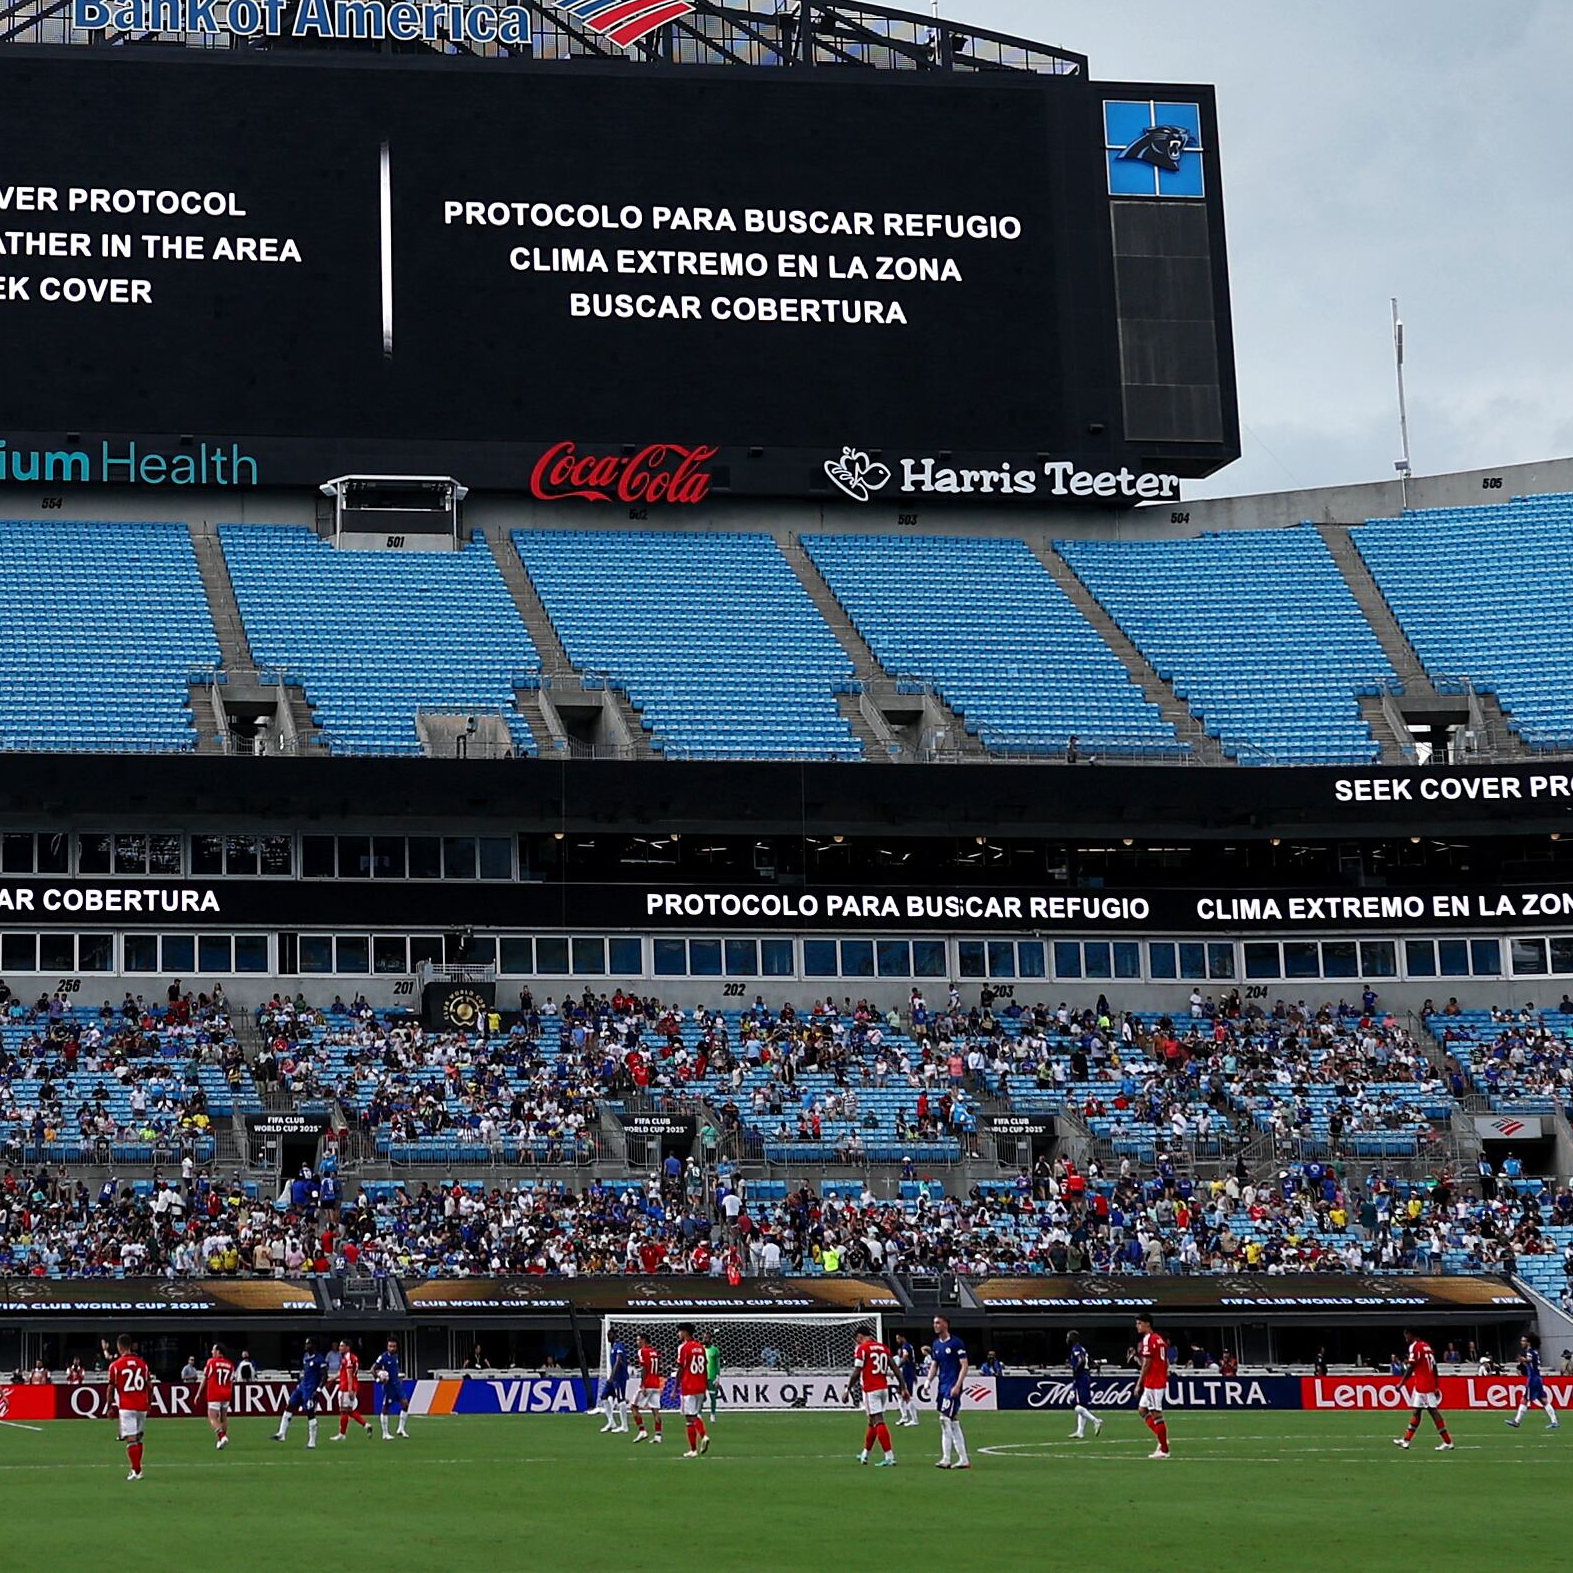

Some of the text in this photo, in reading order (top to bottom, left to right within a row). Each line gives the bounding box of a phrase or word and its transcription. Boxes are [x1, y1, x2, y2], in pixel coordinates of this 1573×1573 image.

[68, 187, 247, 216] PROTOCOL
[444, 201, 1021, 240] PROTOCOLO PARA BUSCAR REFUGIO
[101, 233, 131, 258] IN
[141, 234, 205, 260] THE
[212, 236, 302, 263] AREA
[509, 246, 963, 282] CLIMA EXTREMO EN LA ZONA
[39, 277, 153, 304] COVER
[570, 293, 908, 325] BUSCAR COBERTURA
[102, 440, 258, 485] Health
[530, 440, 719, 504] Coca-Cola
[900, 458, 1179, 497] Harris Teeter
[1482, 477, 1503, 490] 505
[41, 497, 63, 510] 554
[897, 513, 918, 526] 503
[1170, 512, 1190, 524] 504
[386, 536, 405, 548] 501
[1335, 778, 1413, 802] SEEK
[1420, 777, 1522, 800] COVER
[42, 888, 221, 912] COBERTURA
[647, 893, 1150, 919] PROTOCOLO PARA BUSCAR REFUGIO
[1196, 898, 1283, 920] CLIMA
[1288, 896, 1425, 919] EXTREMO
[1432, 895, 1470, 917] EN
[1478, 894, 1517, 917] LA
[56, 978, 82, 993] 256
[393, 981, 414, 995] 201
[722, 983, 747, 997] 202
[991, 984, 1015, 999] 203
[1244, 985, 1268, 999] 204
[74, 1302, 132, 1310] WORLD
[650, 1357, 659, 1374] 11
[689, 1353, 705, 1375] 68
[869, 1351, 888, 1375] 30
[121, 1367, 145, 1392] 26
[215, 1368, 230, 1386] 17
[486, 1380, 577, 1412] VISA
[705, 1384, 770, 1404] ANK
[782, 1384, 815, 1404] OF
[1165, 1381, 1268, 1406] ULTRA
